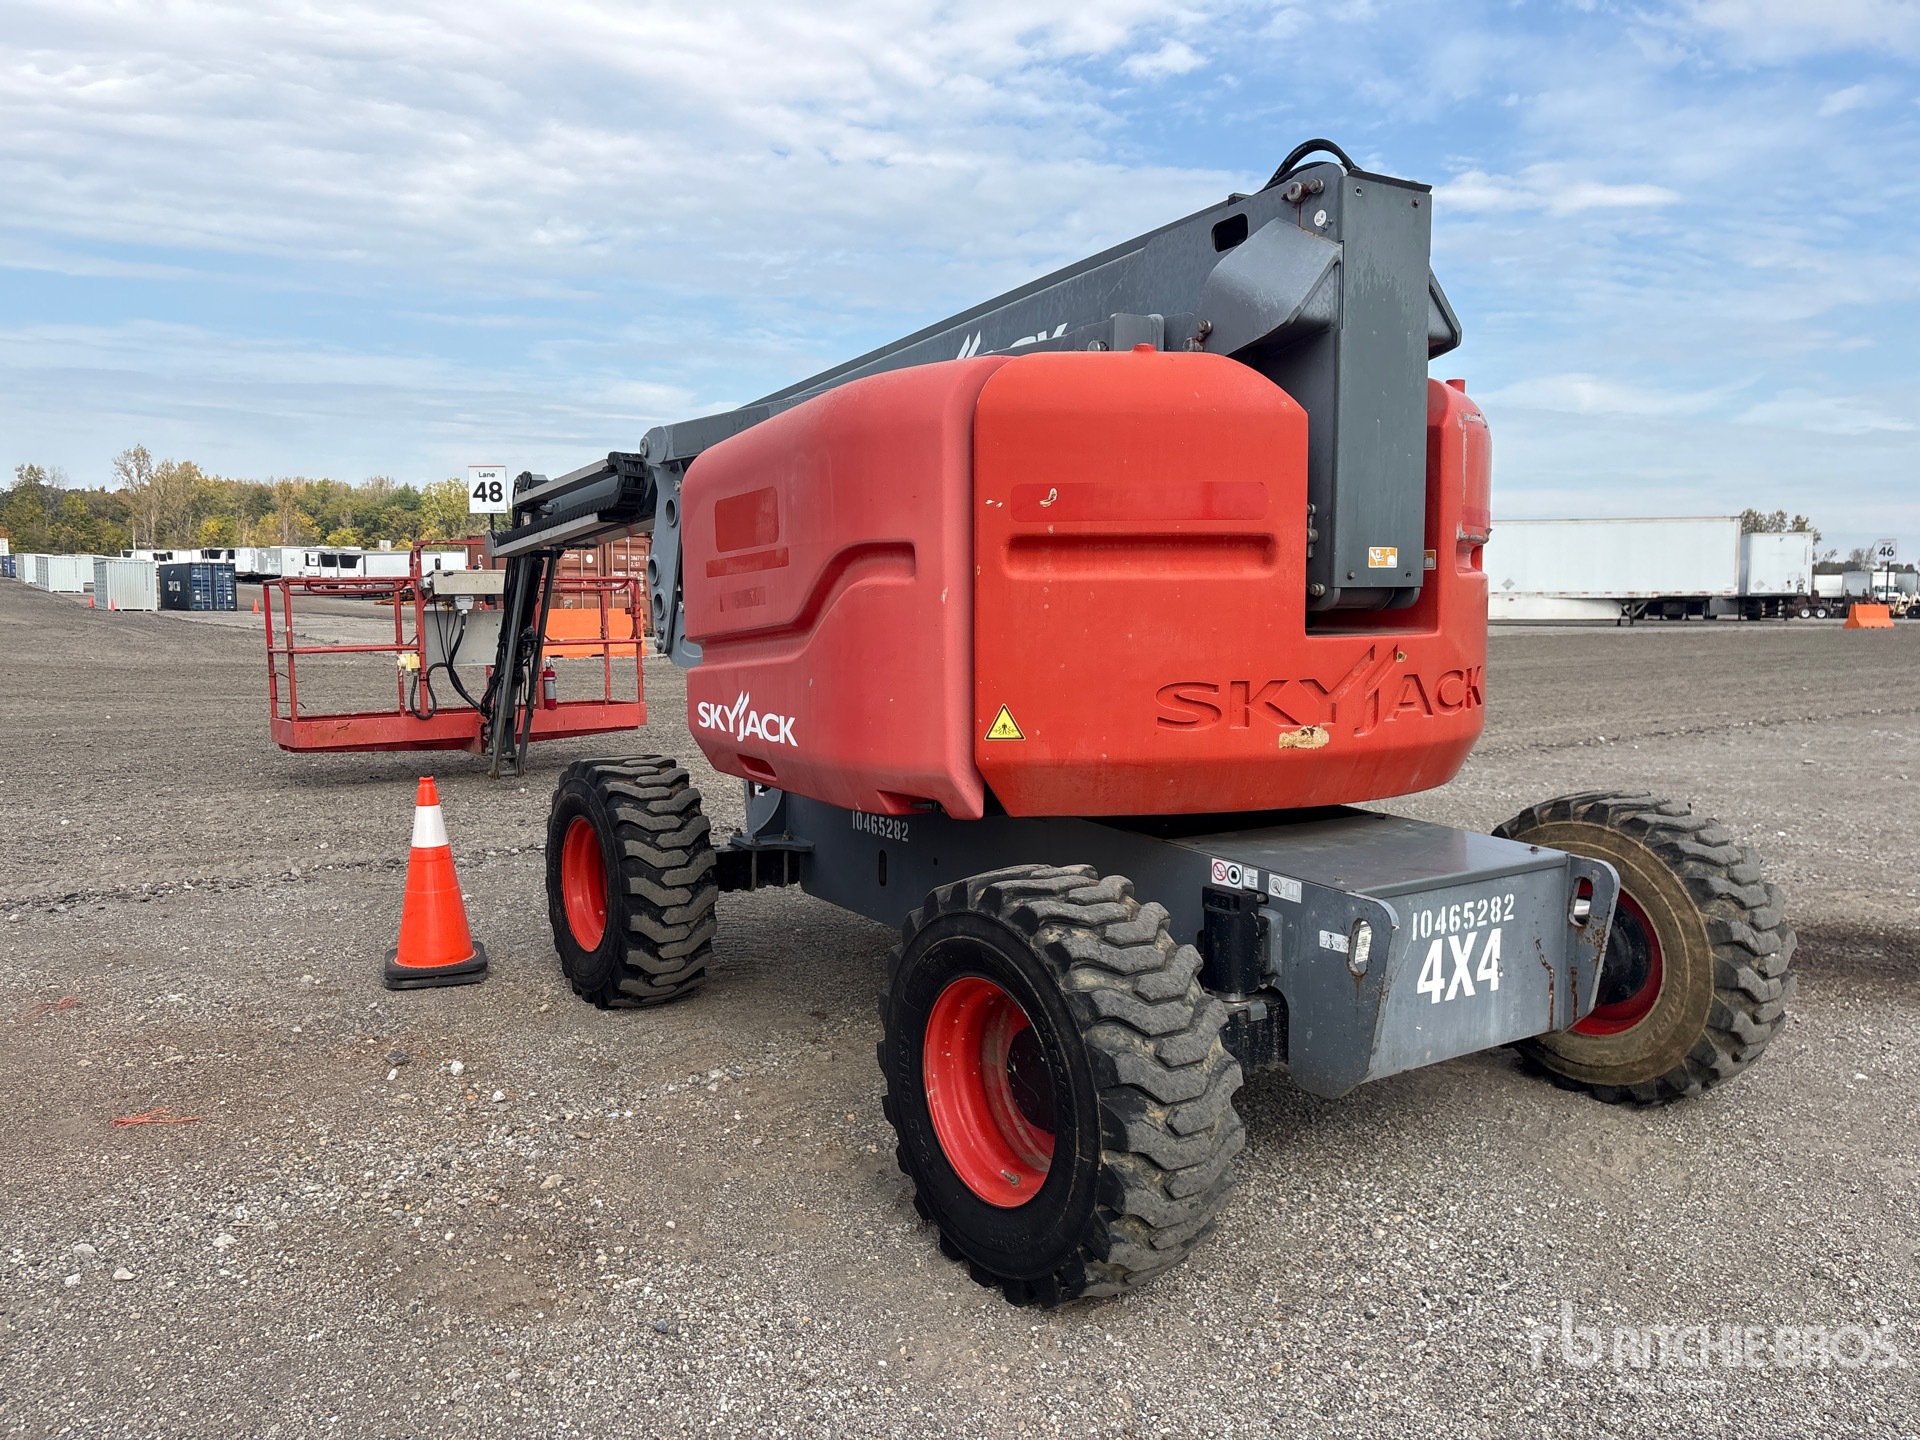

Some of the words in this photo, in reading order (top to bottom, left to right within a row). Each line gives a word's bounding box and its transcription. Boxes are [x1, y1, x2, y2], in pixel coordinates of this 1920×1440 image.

[472, 481, 503, 502] 48
[1879, 546, 1895, 557] 46
[1154, 643, 1483, 738] SKYJACK
[697, 690, 799, 747] SKYJACK
[852, 810, 909, 842] 10465282
[1412, 893, 1515, 941] 10465282
[1416, 927, 1503, 1004] 4X4
